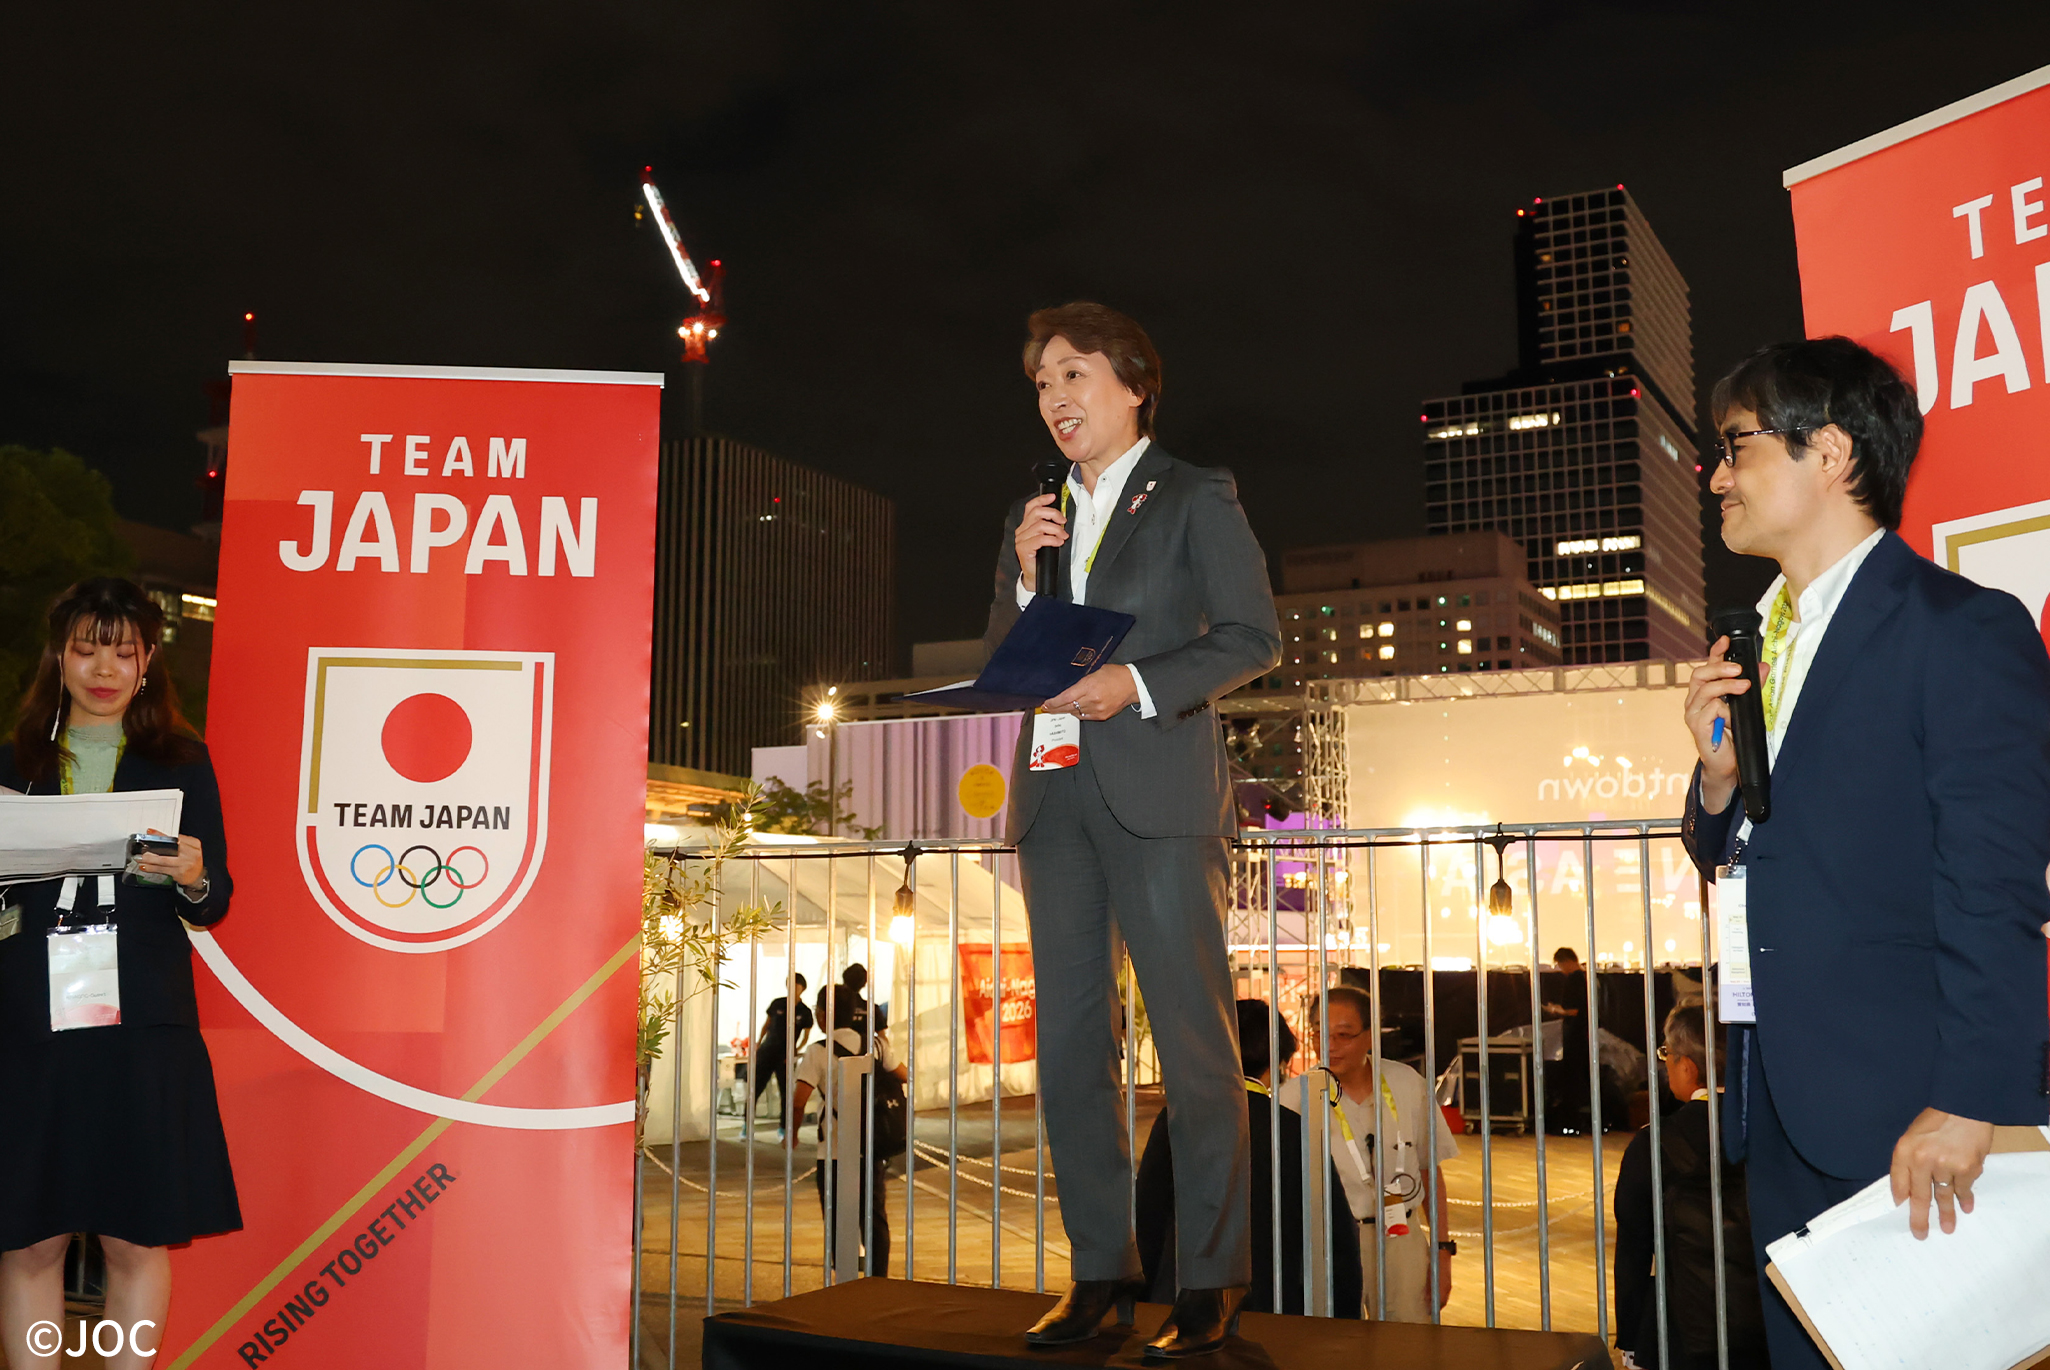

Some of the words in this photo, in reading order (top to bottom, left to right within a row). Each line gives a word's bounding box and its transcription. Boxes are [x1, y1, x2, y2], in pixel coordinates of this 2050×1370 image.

[1952, 176, 2048, 260] TE
[360, 433, 527, 479] TEAM
[279, 489, 598, 577] JAPAN
[334, 803, 413, 828] TEAM
[419, 804, 511, 831] JAPAN
[1001, 1000, 1033, 1022] 2026
[237, 1281, 330, 1370] RISING
[319, 1163, 457, 1287] TOGETHER
